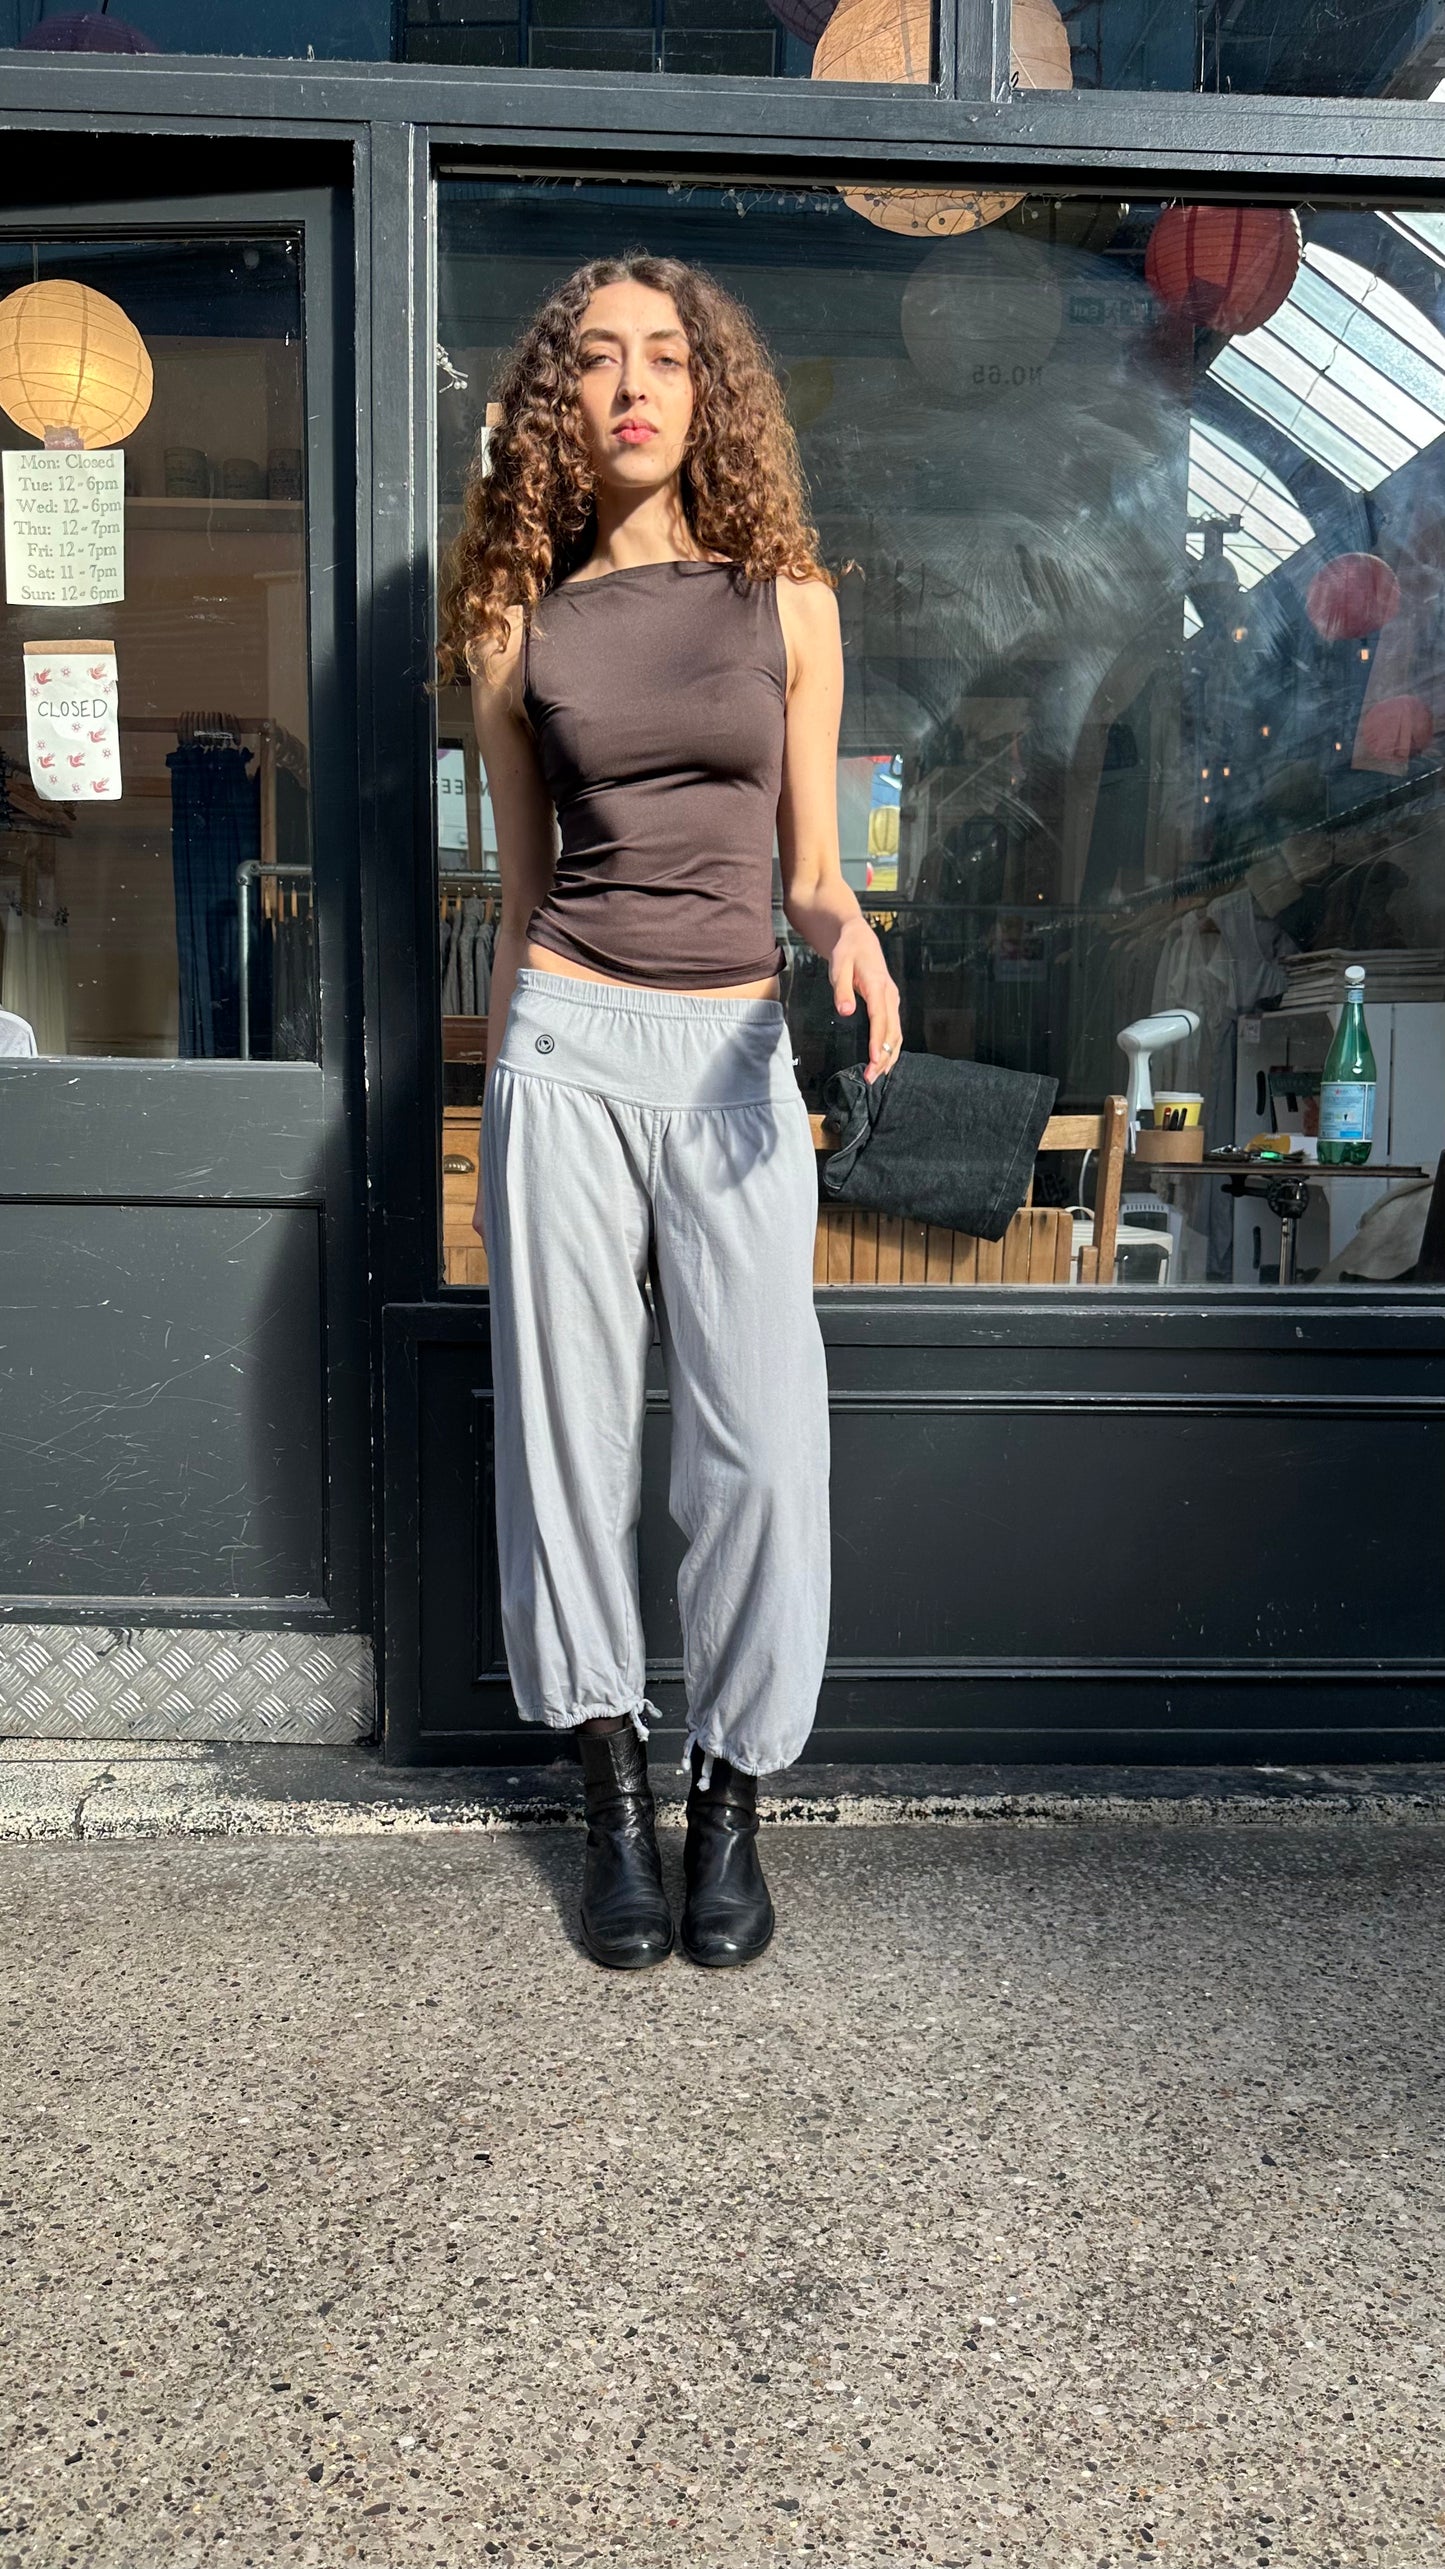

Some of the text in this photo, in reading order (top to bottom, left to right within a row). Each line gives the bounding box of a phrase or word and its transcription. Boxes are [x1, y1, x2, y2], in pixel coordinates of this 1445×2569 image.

[20, 453, 115, 470] Mon: Closed
[18, 477, 53, 492] Tue:
[16, 499, 58, 514] Wed:
[13, 520, 51, 535] Thu:
[27, 542, 53, 557] Fri:
[27, 564, 55, 579] Sat:
[21, 585, 55, 601] Sun:
[37, 698, 108, 719] CLOSED
